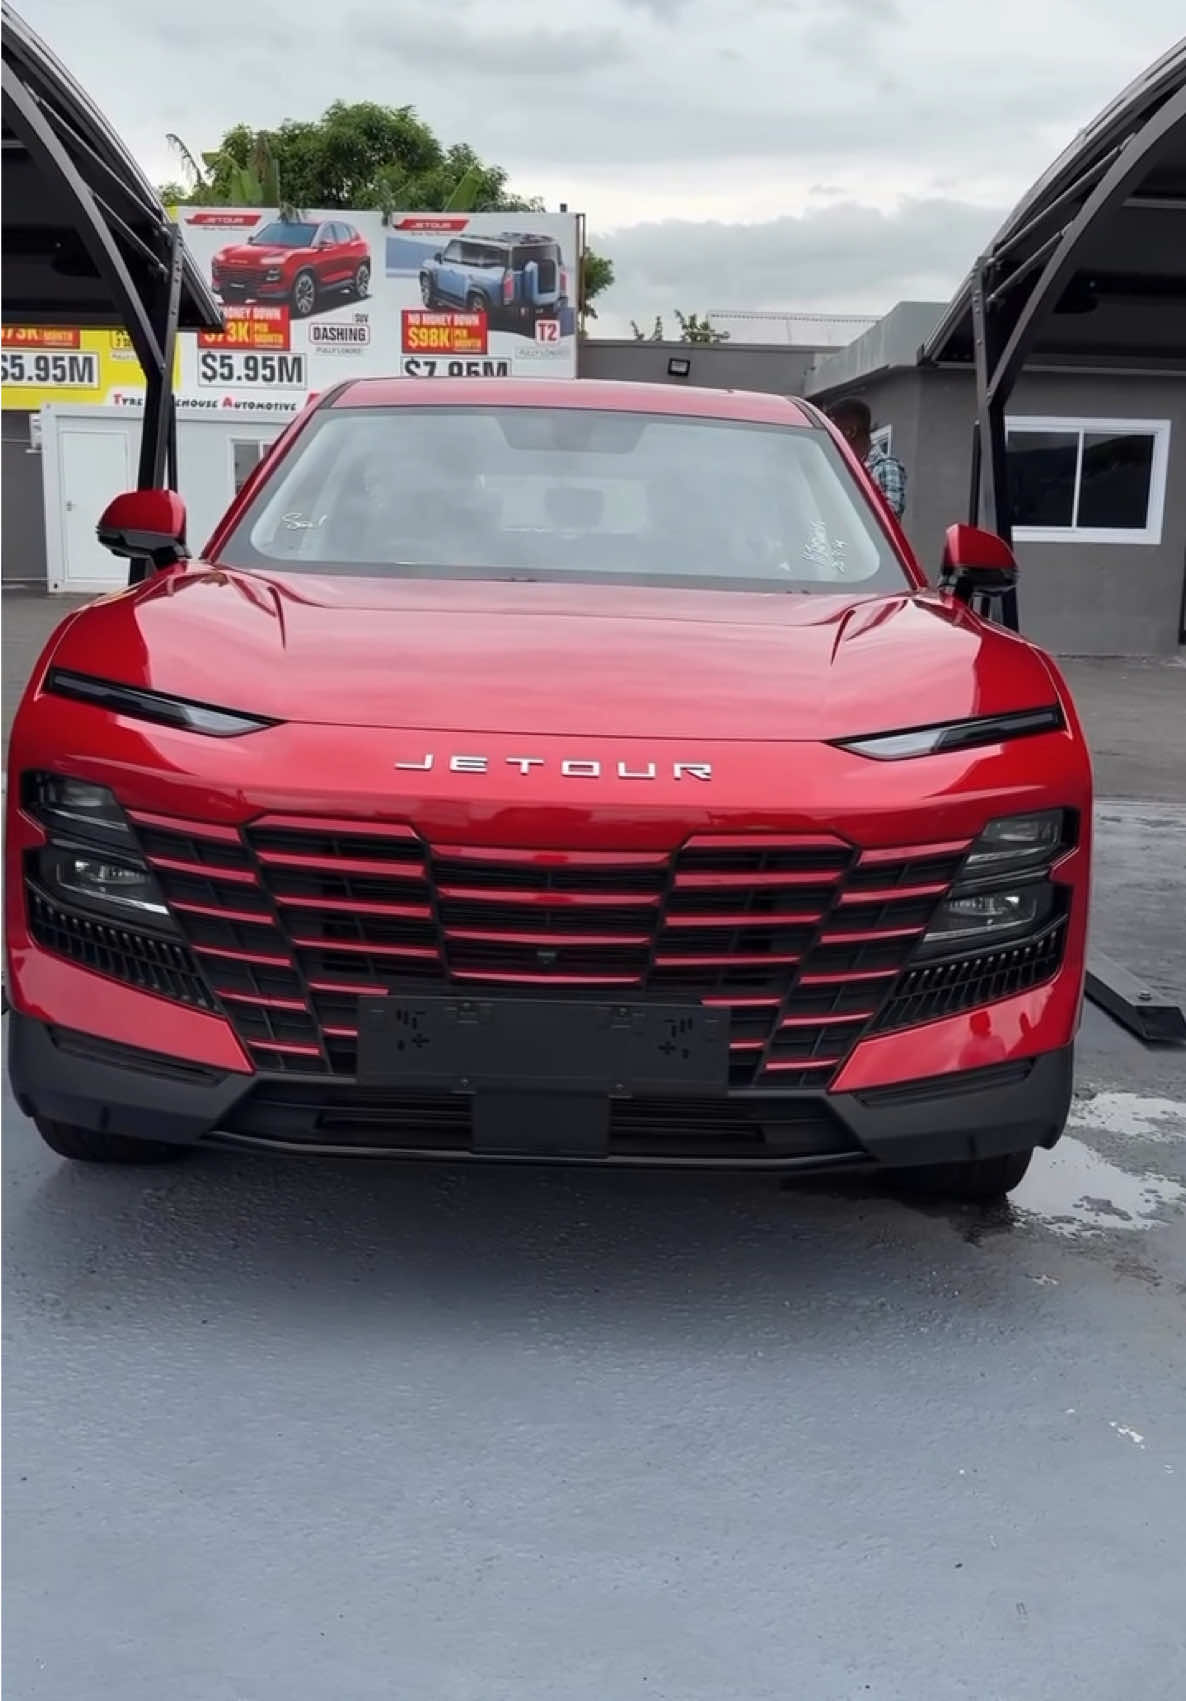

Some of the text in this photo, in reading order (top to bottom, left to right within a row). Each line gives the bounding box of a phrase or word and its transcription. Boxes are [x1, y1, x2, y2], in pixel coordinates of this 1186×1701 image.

[313, 327, 366, 341] DASHING
[407, 327, 449, 348] $98K
[538, 322, 557, 341] T2
[201, 351, 302, 383] $5.95M
[404, 357, 508, 376] $795M
[394, 753, 712, 780] JETOUR
